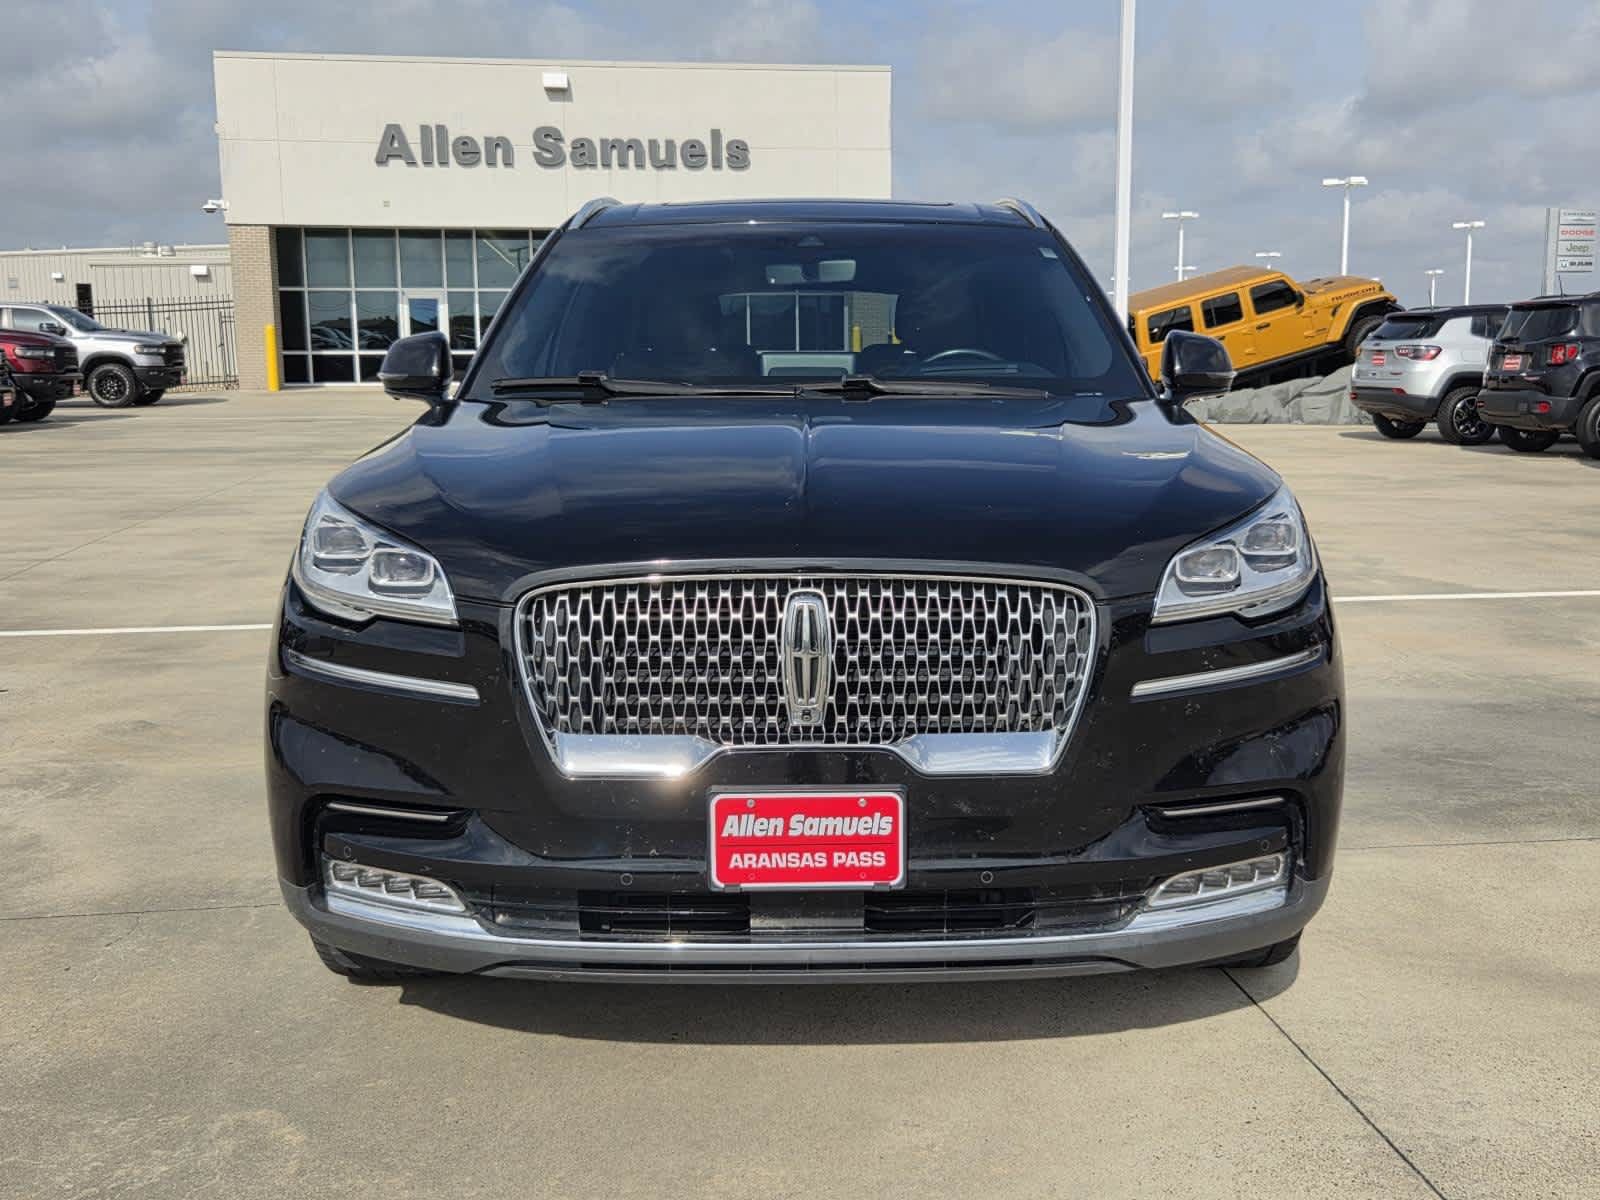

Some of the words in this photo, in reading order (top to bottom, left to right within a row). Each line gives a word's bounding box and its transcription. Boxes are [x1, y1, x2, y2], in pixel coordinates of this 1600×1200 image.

[375, 123, 514, 168] Allen
[532, 125, 751, 171] Samuels
[1566, 242, 1590, 253] Jeep
[720, 813, 785, 837] Allen
[788, 811, 893, 837] Samuels
[728, 851, 828, 869] ARANSAS
[832, 850, 887, 868] PASS
